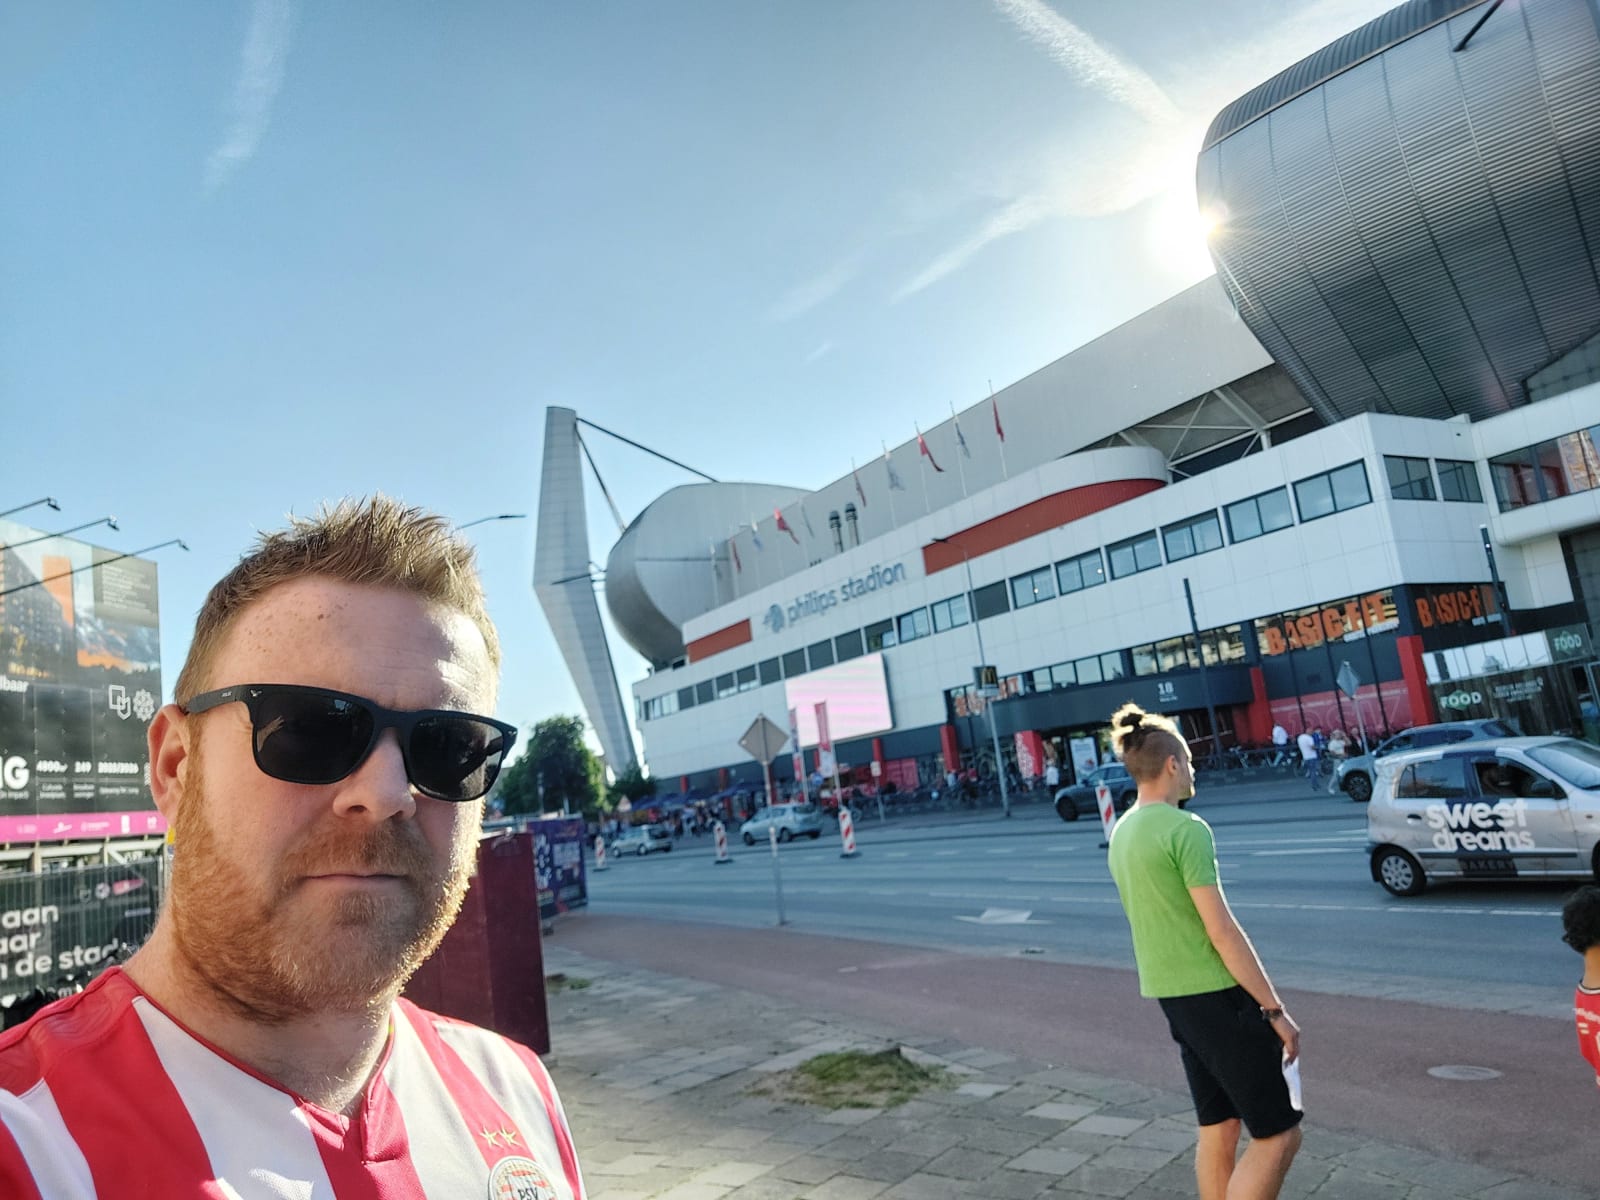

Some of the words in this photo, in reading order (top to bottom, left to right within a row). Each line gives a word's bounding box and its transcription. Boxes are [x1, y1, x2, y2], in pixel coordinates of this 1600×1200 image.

[787, 589, 838, 627] philips
[840, 562, 906, 602] stadion
[1554, 634, 1582, 651] FOOD
[1441, 691, 1482, 709] FOOD
[1425, 798, 1529, 830] sweet
[1433, 827, 1535, 851] dreams
[15, 951, 52, 977] de
